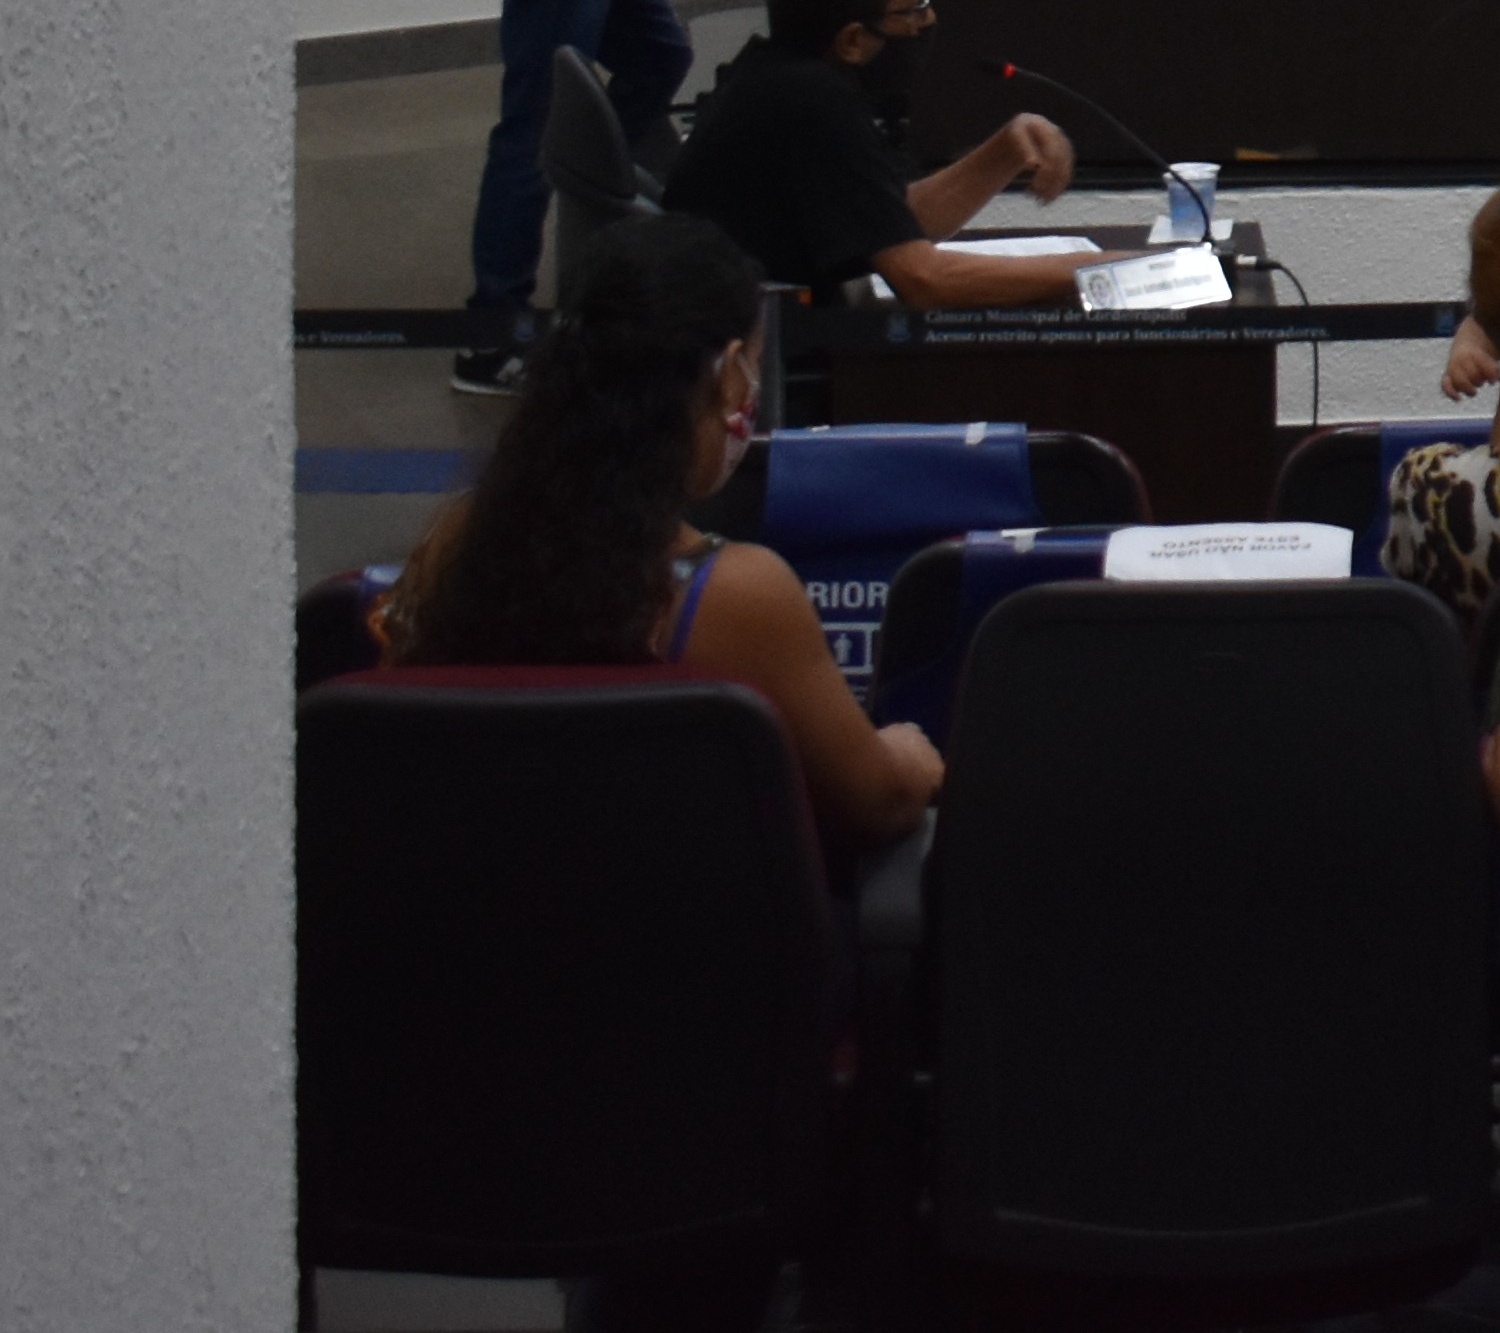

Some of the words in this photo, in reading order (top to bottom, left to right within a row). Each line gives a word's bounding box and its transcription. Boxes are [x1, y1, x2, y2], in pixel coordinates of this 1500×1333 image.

[924, 310, 983, 323] Câmara
[986, 308, 1060, 325] Municipal
[1095, 330, 1131, 345] para
[1162, 536, 1248, 548] ASSENTO
[1254, 535, 1300, 543] ESTE
[1205, 544, 1244, 554] NÃO
[1249, 542, 1312, 552] FAVOR
[1150, 548, 1200, 558] USAR
